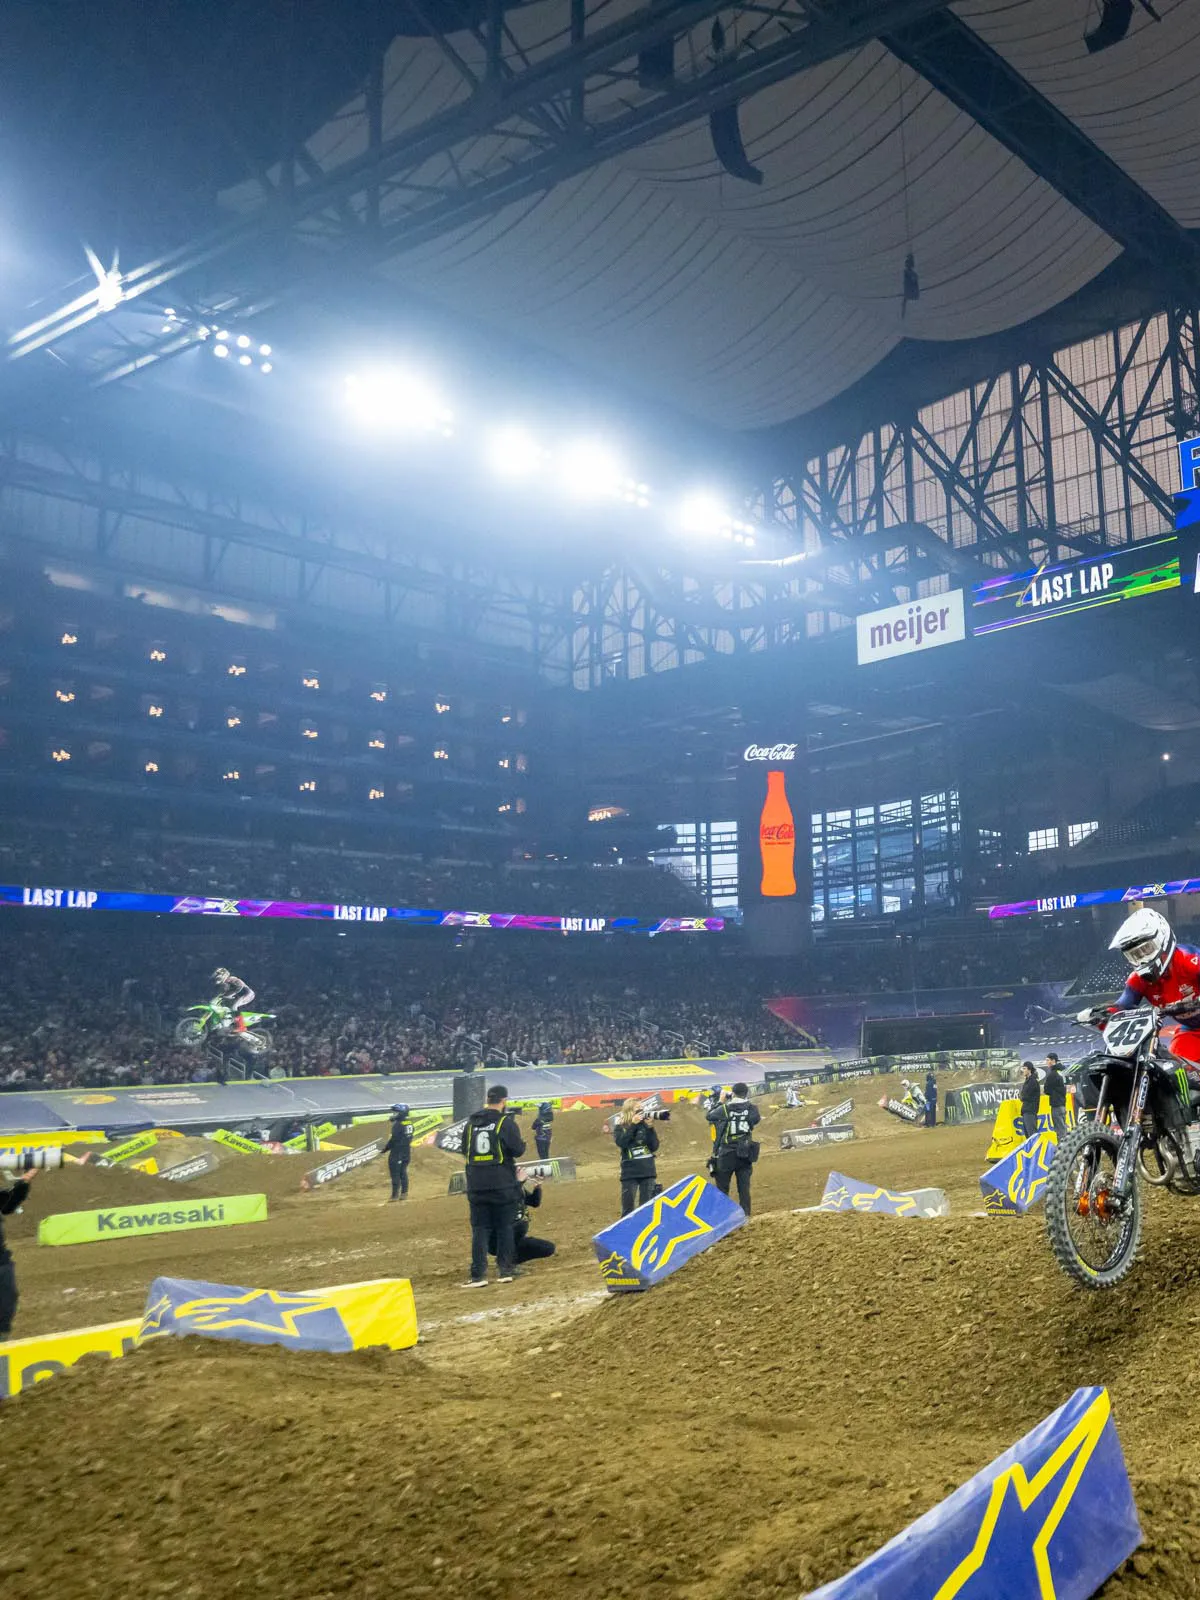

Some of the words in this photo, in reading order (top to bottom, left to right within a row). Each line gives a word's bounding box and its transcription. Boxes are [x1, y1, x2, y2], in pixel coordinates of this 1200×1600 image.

[1031, 574, 1073, 607] LAST
[1080, 562, 1114, 594] LAP
[870, 605, 950, 649] meijer
[744, 743, 798, 761] Coca-Cola
[23, 888, 65, 906] LAST
[67, 890, 98, 908] LAP
[1142, 883, 1167, 896] SMX
[333, 905, 363, 921] LAST
[365, 907, 388, 922] LAP
[1036, 898, 1059, 912] LAST
[1061, 895, 1077, 909] LAP
[560, 917, 583, 931] LAST
[585, 919, 605, 931] LAP
[1107, 1017, 1149, 1047] 46
[477, 1131, 490, 1154] 6
[98, 1204, 225, 1232] Kawasaki
